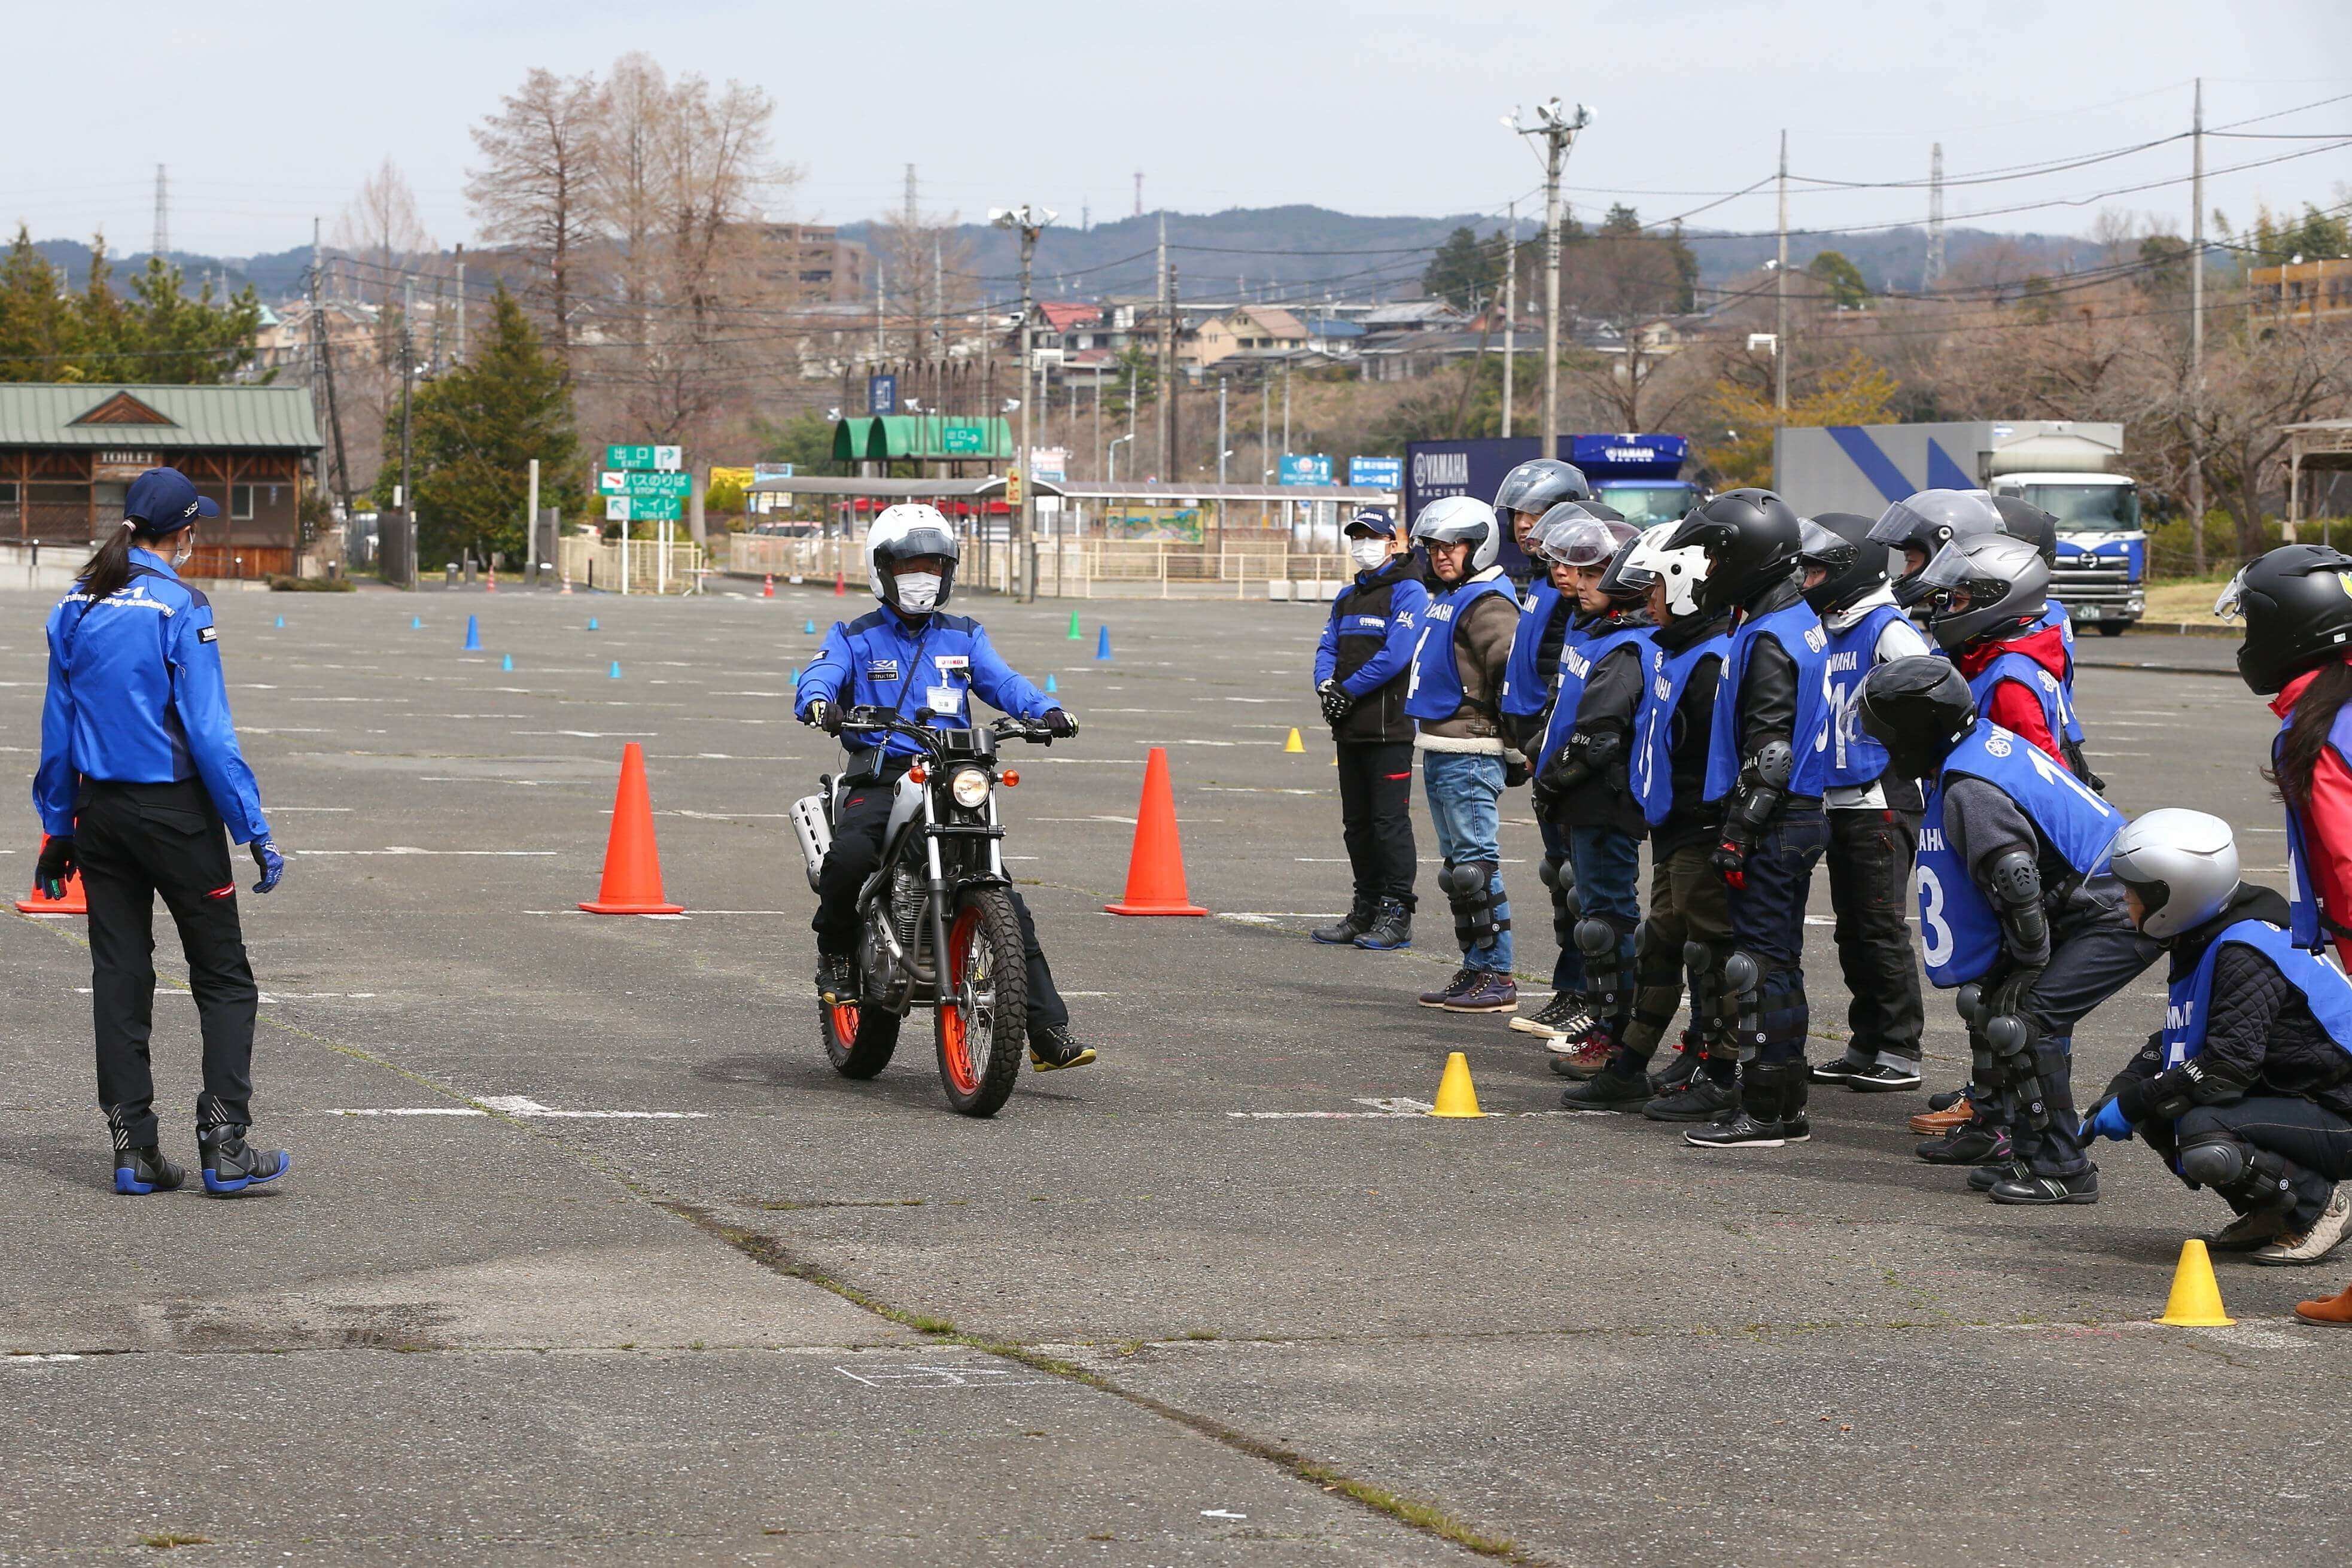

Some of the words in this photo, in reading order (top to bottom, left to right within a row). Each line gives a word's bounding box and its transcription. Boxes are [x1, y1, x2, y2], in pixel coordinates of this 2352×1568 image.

[101, 452, 154, 463] TOILET
[614, 447, 649, 459] 出口
[1617, 448, 1655, 458] YAMAHA
[1426, 453, 1469, 485] YAMAHA
[1417, 488, 1465, 497] RACING
[632, 499, 677, 510] トイレ
[1830, 651, 1857, 672] MAHA
[1919, 828, 1945, 852] AHA
